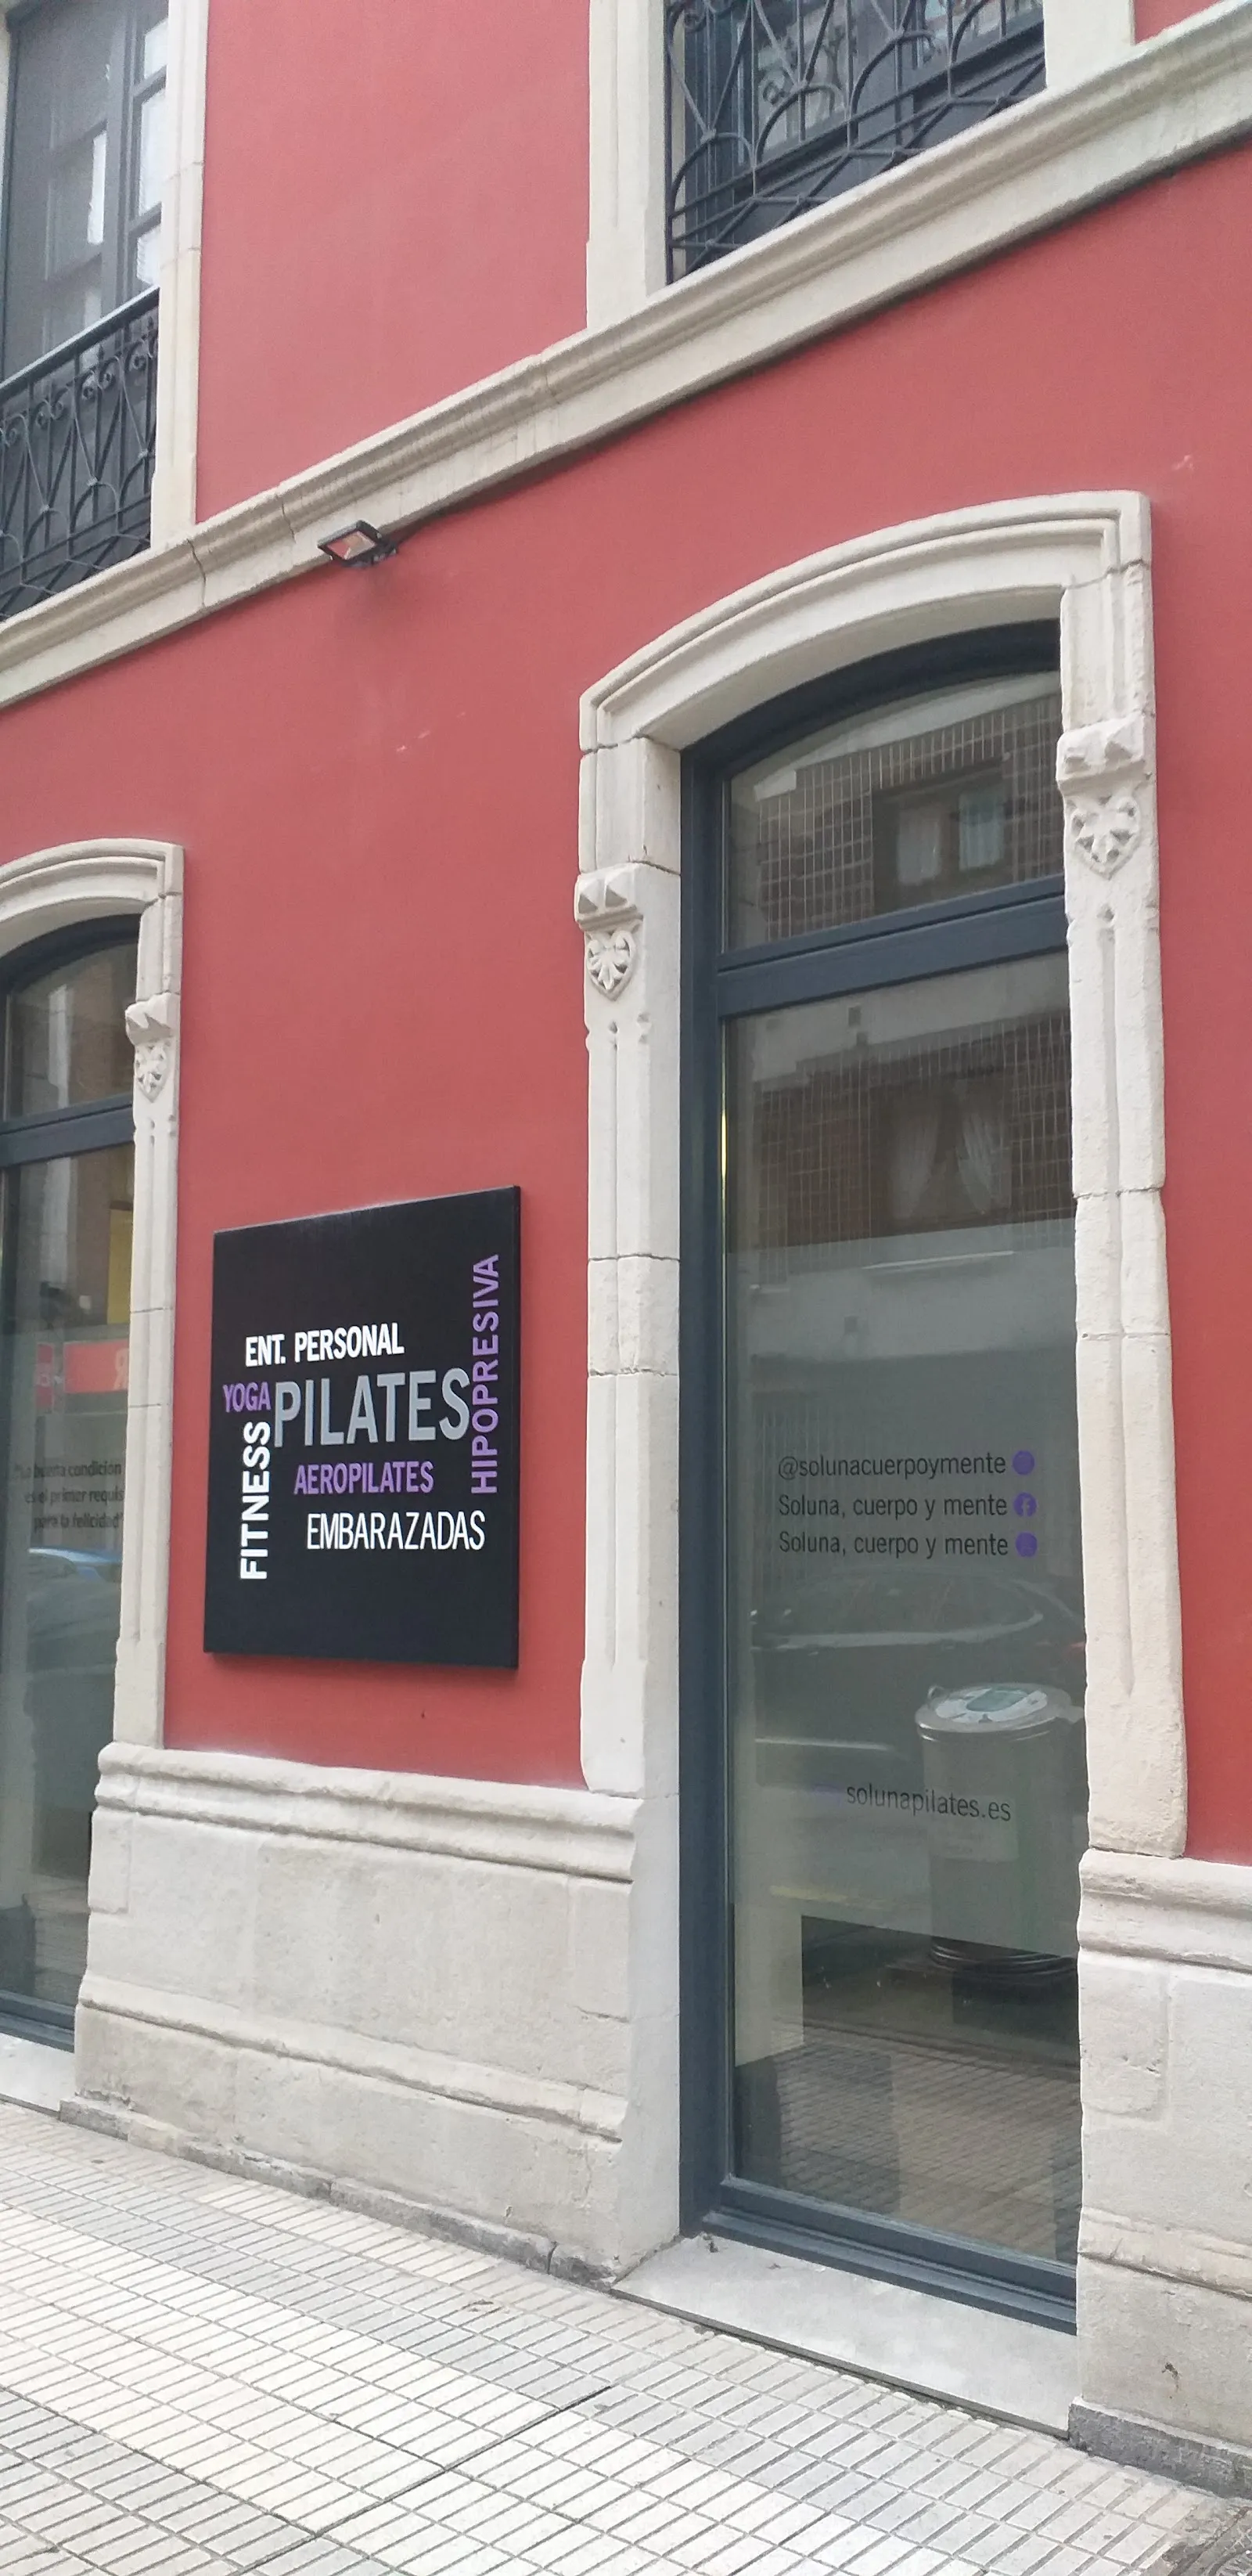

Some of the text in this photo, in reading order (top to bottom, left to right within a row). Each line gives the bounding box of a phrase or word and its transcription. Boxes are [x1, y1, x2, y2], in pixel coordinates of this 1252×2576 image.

[246, 1323, 405, 1367] ENT. PERSONAL
[472, 1255, 498, 1493] HIPOPRESIVA
[223, 1382, 272, 1412] YOGA
[273, 1367, 470, 1448] PILATES
[294, 1461, 434, 1495] AEROPILATES
[778, 1453, 1006, 1480] @solunacuerpoymente
[240, 1421, 270, 1580] FITNESS
[779, 1494, 1008, 1521] Soluna, cuerpo y mente
[308, 1510, 485, 1550] EMBARAZADAS
[780, 1531, 1009, 1560] Soluna, cuerpo y mente
[847, 1782, 1011, 1821] solunapilates.es
